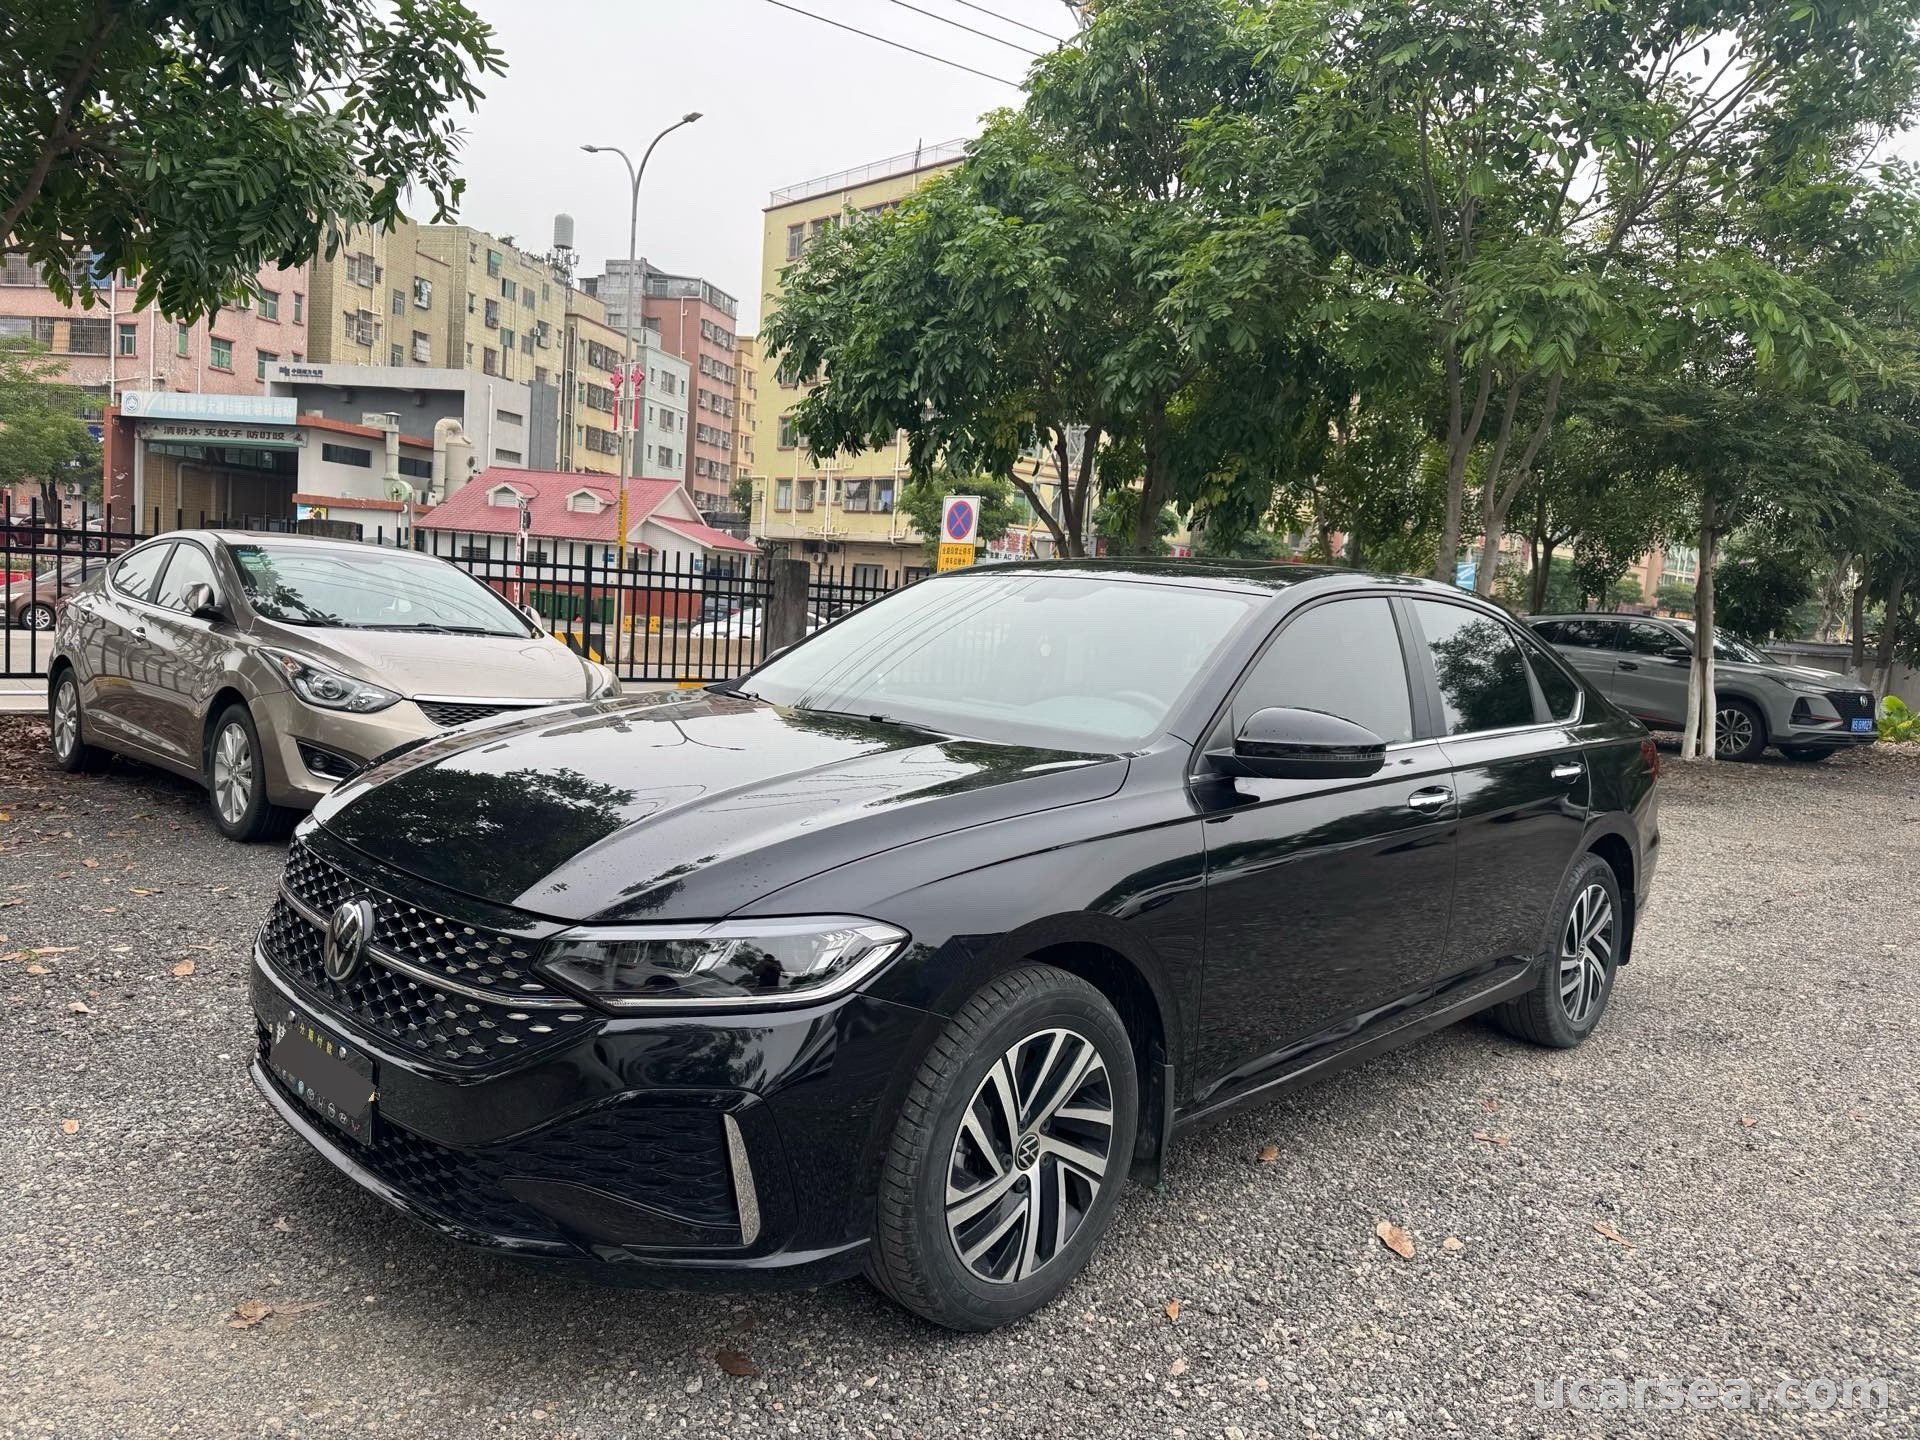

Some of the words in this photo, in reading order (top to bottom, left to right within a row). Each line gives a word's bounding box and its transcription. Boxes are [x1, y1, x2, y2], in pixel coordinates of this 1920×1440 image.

[163, 426, 201, 436] 清积水
[204, 427, 243, 438] 灭蚊子
[246, 430, 285, 440] 防叮咬
